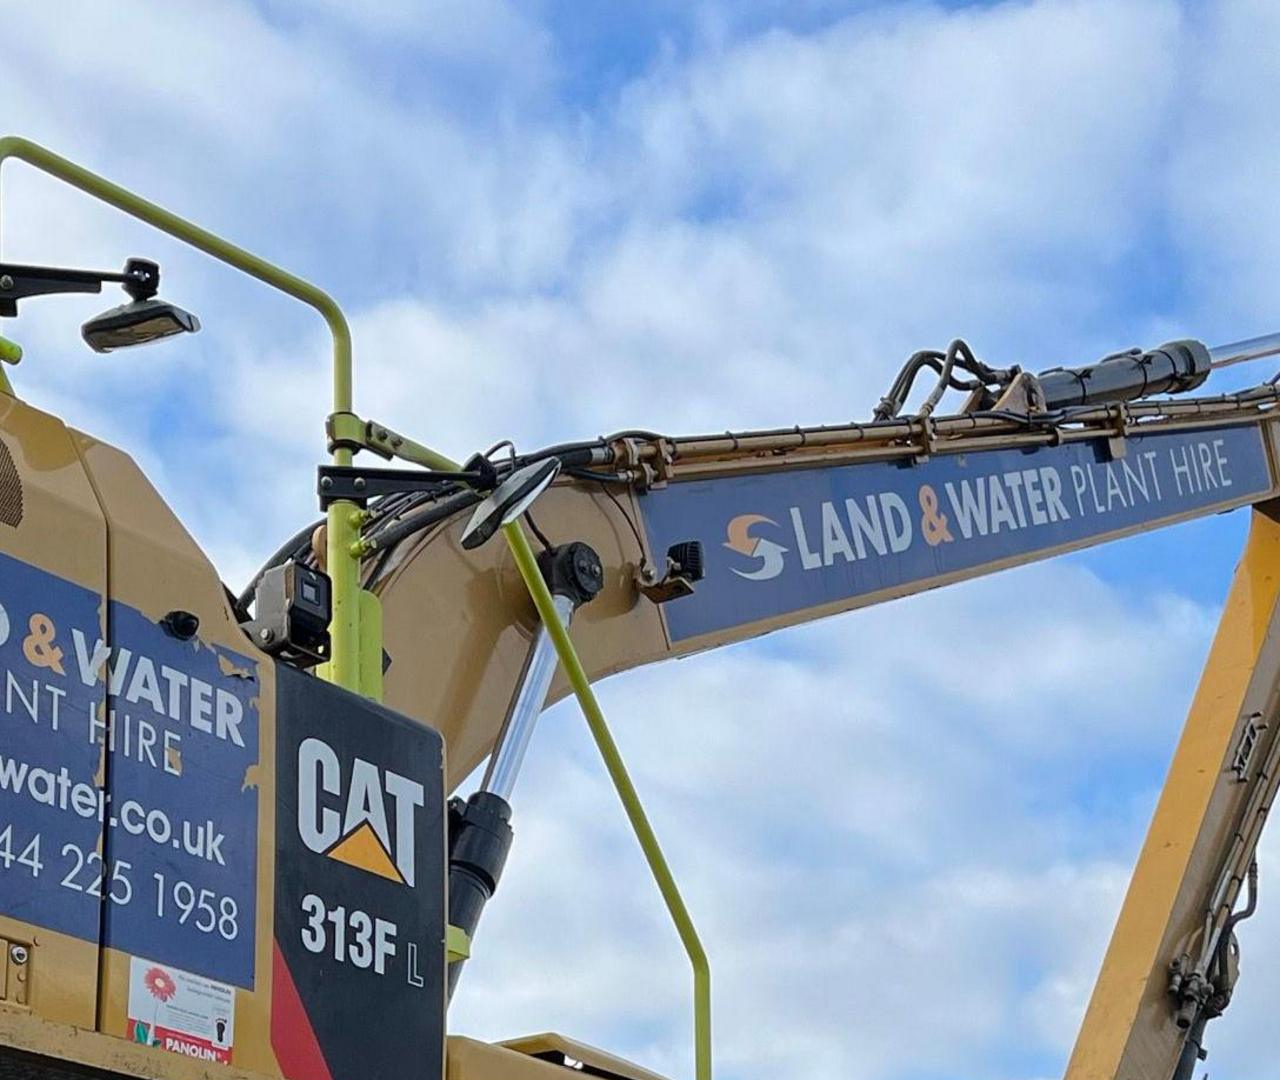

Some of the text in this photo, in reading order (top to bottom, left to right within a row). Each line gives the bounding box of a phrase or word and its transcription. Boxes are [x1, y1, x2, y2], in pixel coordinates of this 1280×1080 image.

[790, 439, 1233, 570] LAND & WATER PLANT HIRE
[23, 612, 67, 676] &
[71, 628, 246, 748] WATER
[89, 701, 182, 777] HIRE
[297, 737, 425, 888] CAT
[60, 843, 133, 906] 225
[153, 872, 239, 941] 1958
[301, 894, 424, 988] 313F L
[166, 1037, 217, 1062] PANOLIN
